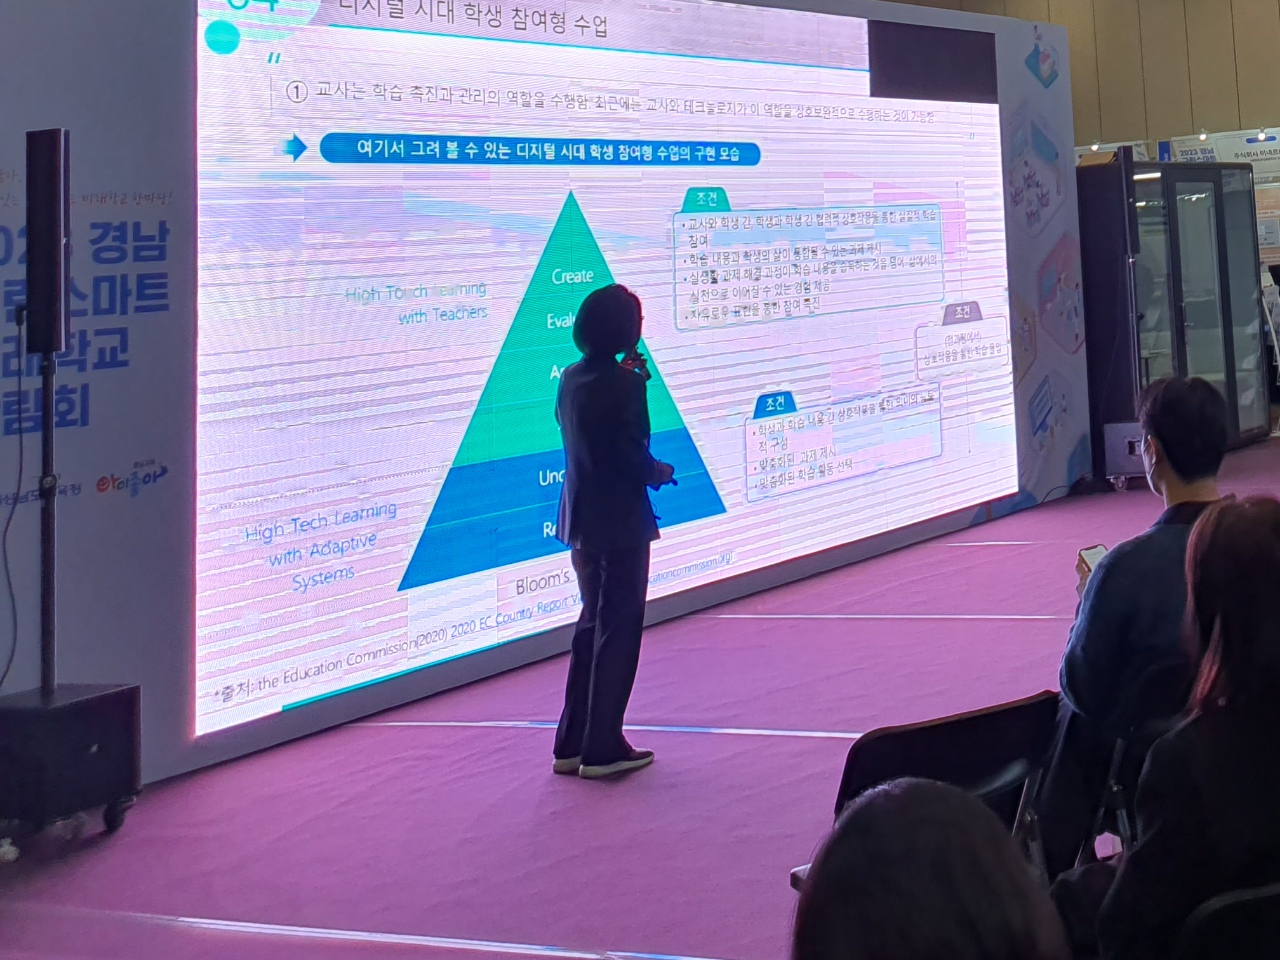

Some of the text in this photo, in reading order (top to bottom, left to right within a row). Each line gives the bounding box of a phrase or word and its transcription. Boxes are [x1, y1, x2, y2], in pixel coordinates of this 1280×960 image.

[463, 1, 503, 29] 학생
[511, 6, 566, 35] 참여형
[573, 14, 608, 39] 수업
[315, 81, 366, 100] 교사는
[372, 83, 405, 102] 학습
[410, 85, 454, 105] 촉진과
[458, 88, 501, 107] 관리의
[506, 90, 547, 108] 역할을
[595, 95, 642, 113] 최근에는
[646, 97, 680, 114] 교사와
[684, 98, 747, 116] 테크놀로지가
[751, 102, 760, 117] 이
[357, 139, 741, 162] 여기서 그려 볼 수 있는 디지털 시대 학생 참여형 수업의 구현 모습
[696, 191, 718, 207] 조건
[688, 217, 717, 231] 교사와
[721, 216, 739, 231] 학생
[756, 215, 782, 229] 학생과
[785, 215, 802, 228] 학생
[88, 220, 171, 265] 경남
[688, 234, 708, 249] 참여
[712, 251, 740, 266] 내용과
[551, 268, 595, 285] Create
[774, 283, 792, 297] 있는
[399, 306, 488, 325] with Teachers
[955, 305, 971, 319] 조건
[765, 395, 786, 411] 조건
[758, 422, 786, 437] 학생과
[787, 417, 805, 433] 학습
[244, 502, 397, 545] High Tech Learning
[268, 532, 378, 567] with Adaptive
[292, 566, 355, 594] Systems
[516, 569, 571, 595] Bloom's
[258, 675, 279, 692] the
[283, 659, 343, 684] Education
[451, 620, 477, 638] 2020
[479, 616, 492, 629] EC
[495, 607, 534, 628] Country
[536, 597, 569, 614] Report
